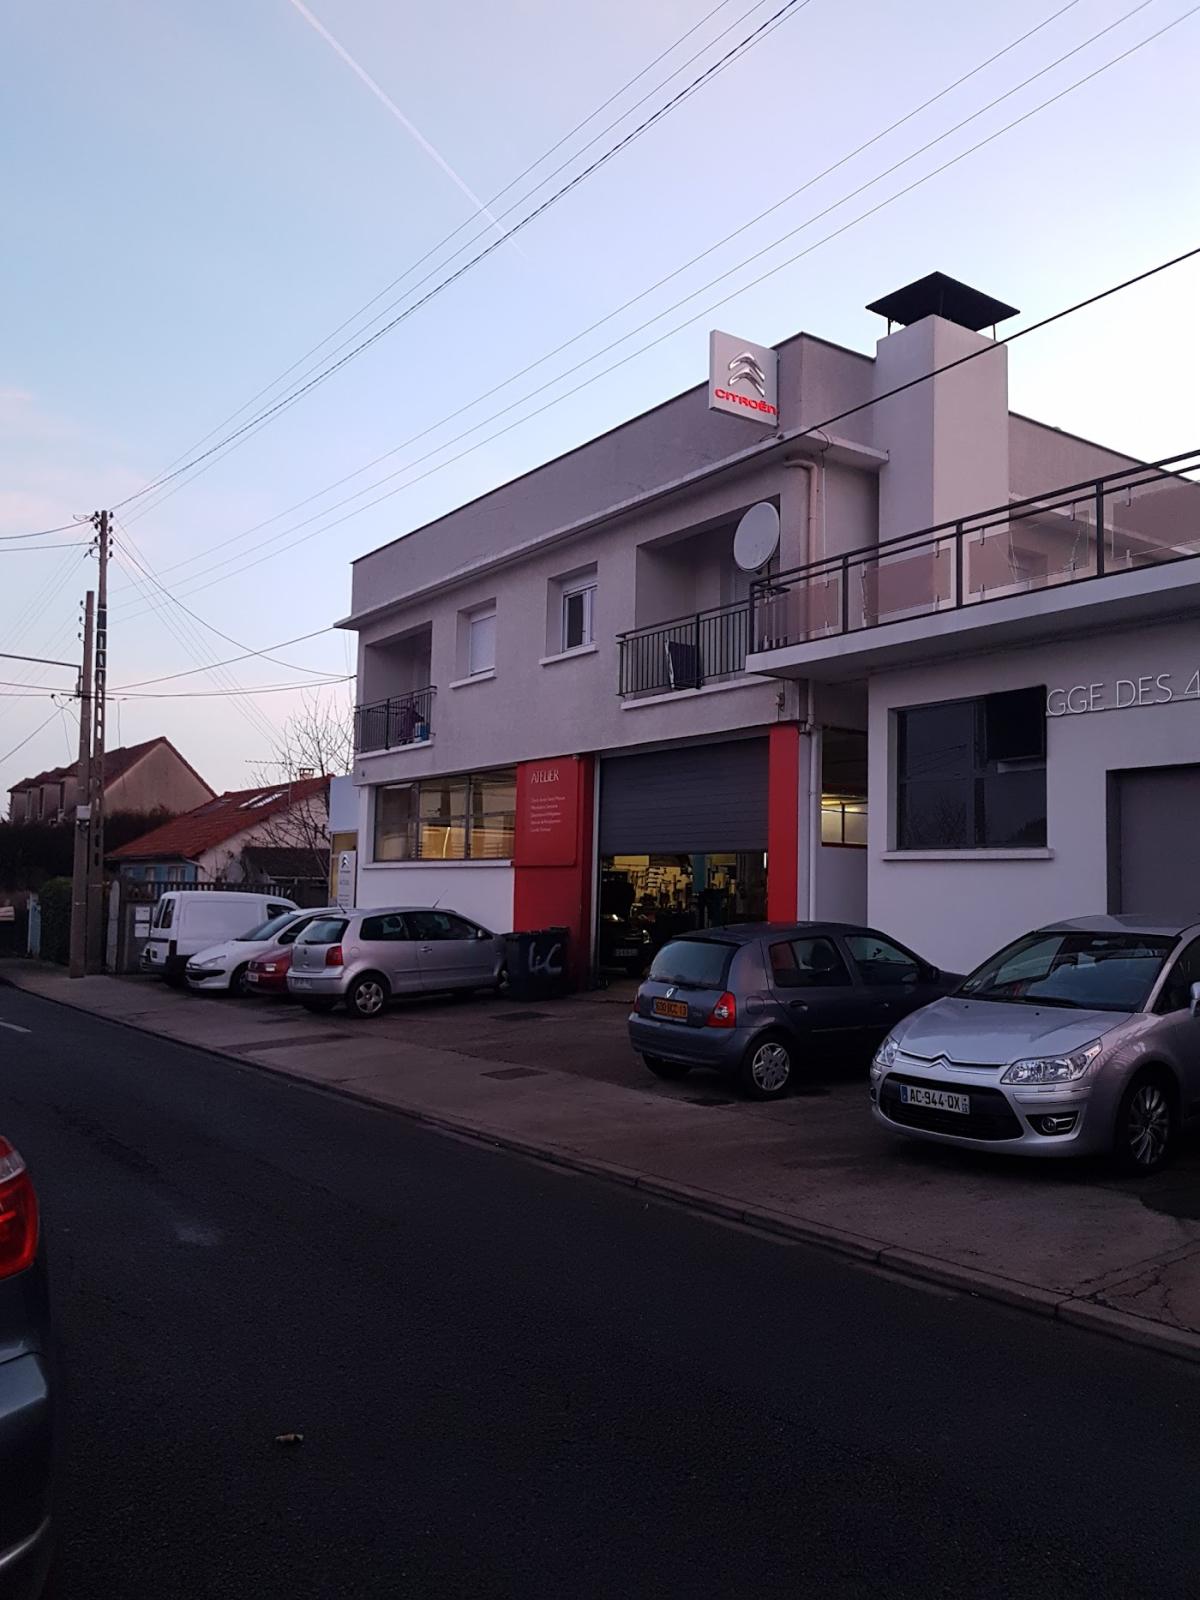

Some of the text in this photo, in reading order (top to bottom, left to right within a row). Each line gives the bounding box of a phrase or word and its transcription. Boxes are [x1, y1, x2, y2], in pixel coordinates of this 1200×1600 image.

[715, 389, 777, 415] CITROËN
[1046, 683, 1105, 716] GGE
[1116, 673, 1173, 708] DES
[531, 769, 560, 784] ATELIER
